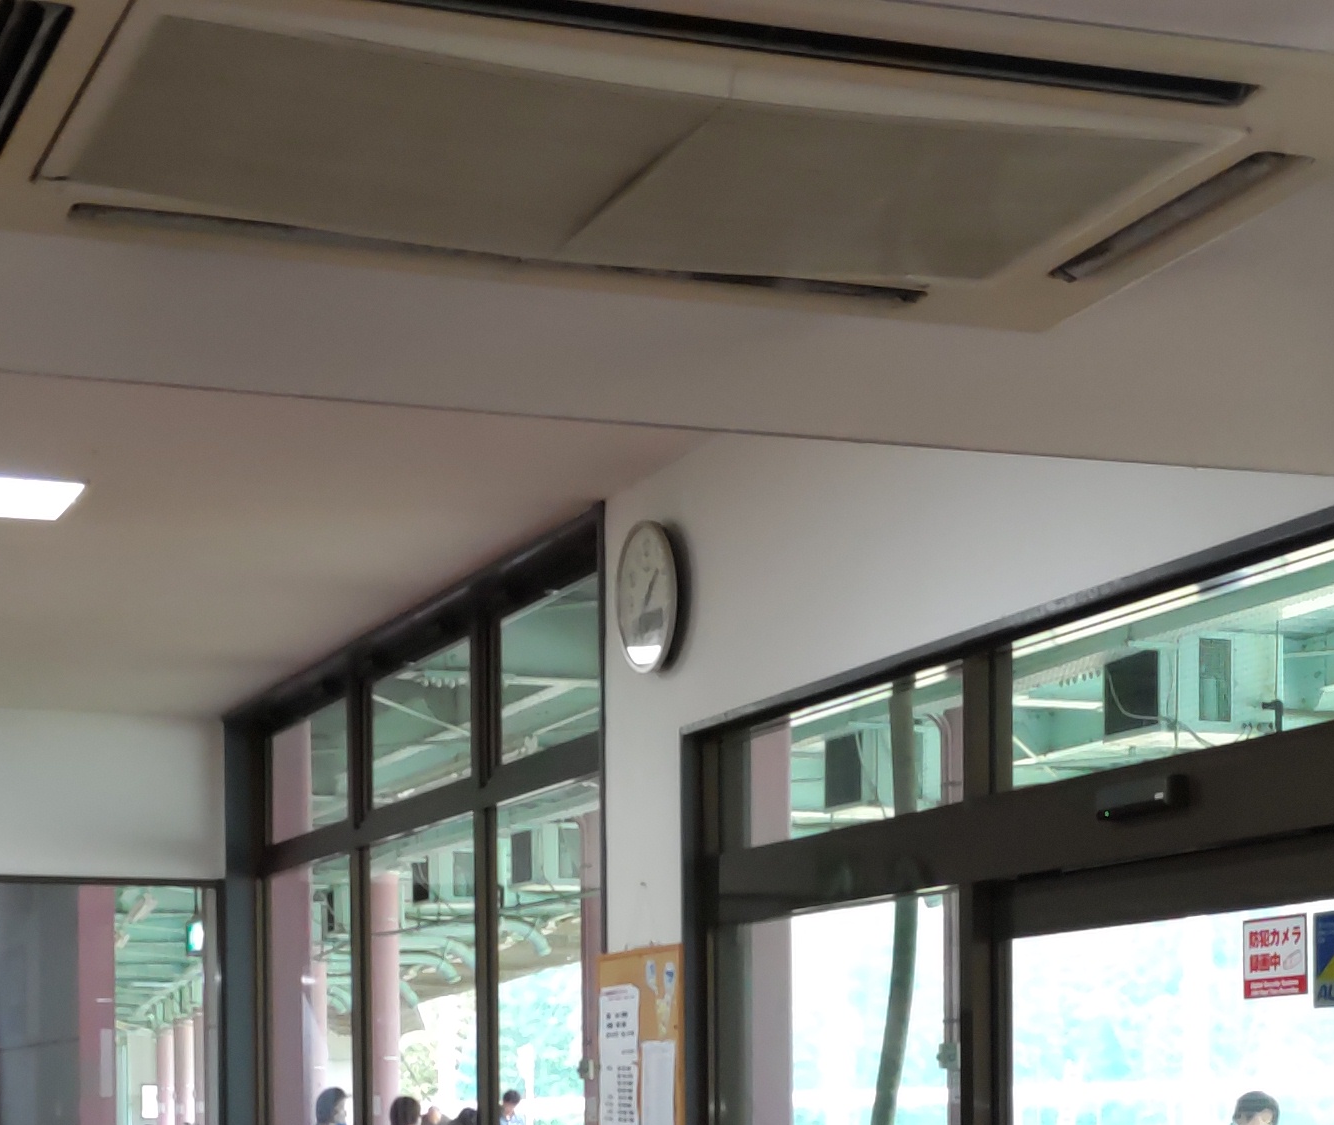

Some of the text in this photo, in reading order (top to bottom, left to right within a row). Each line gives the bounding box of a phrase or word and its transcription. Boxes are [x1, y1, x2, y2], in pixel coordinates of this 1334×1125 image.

[1249, 926, 1302, 949] 防犯カメラ
